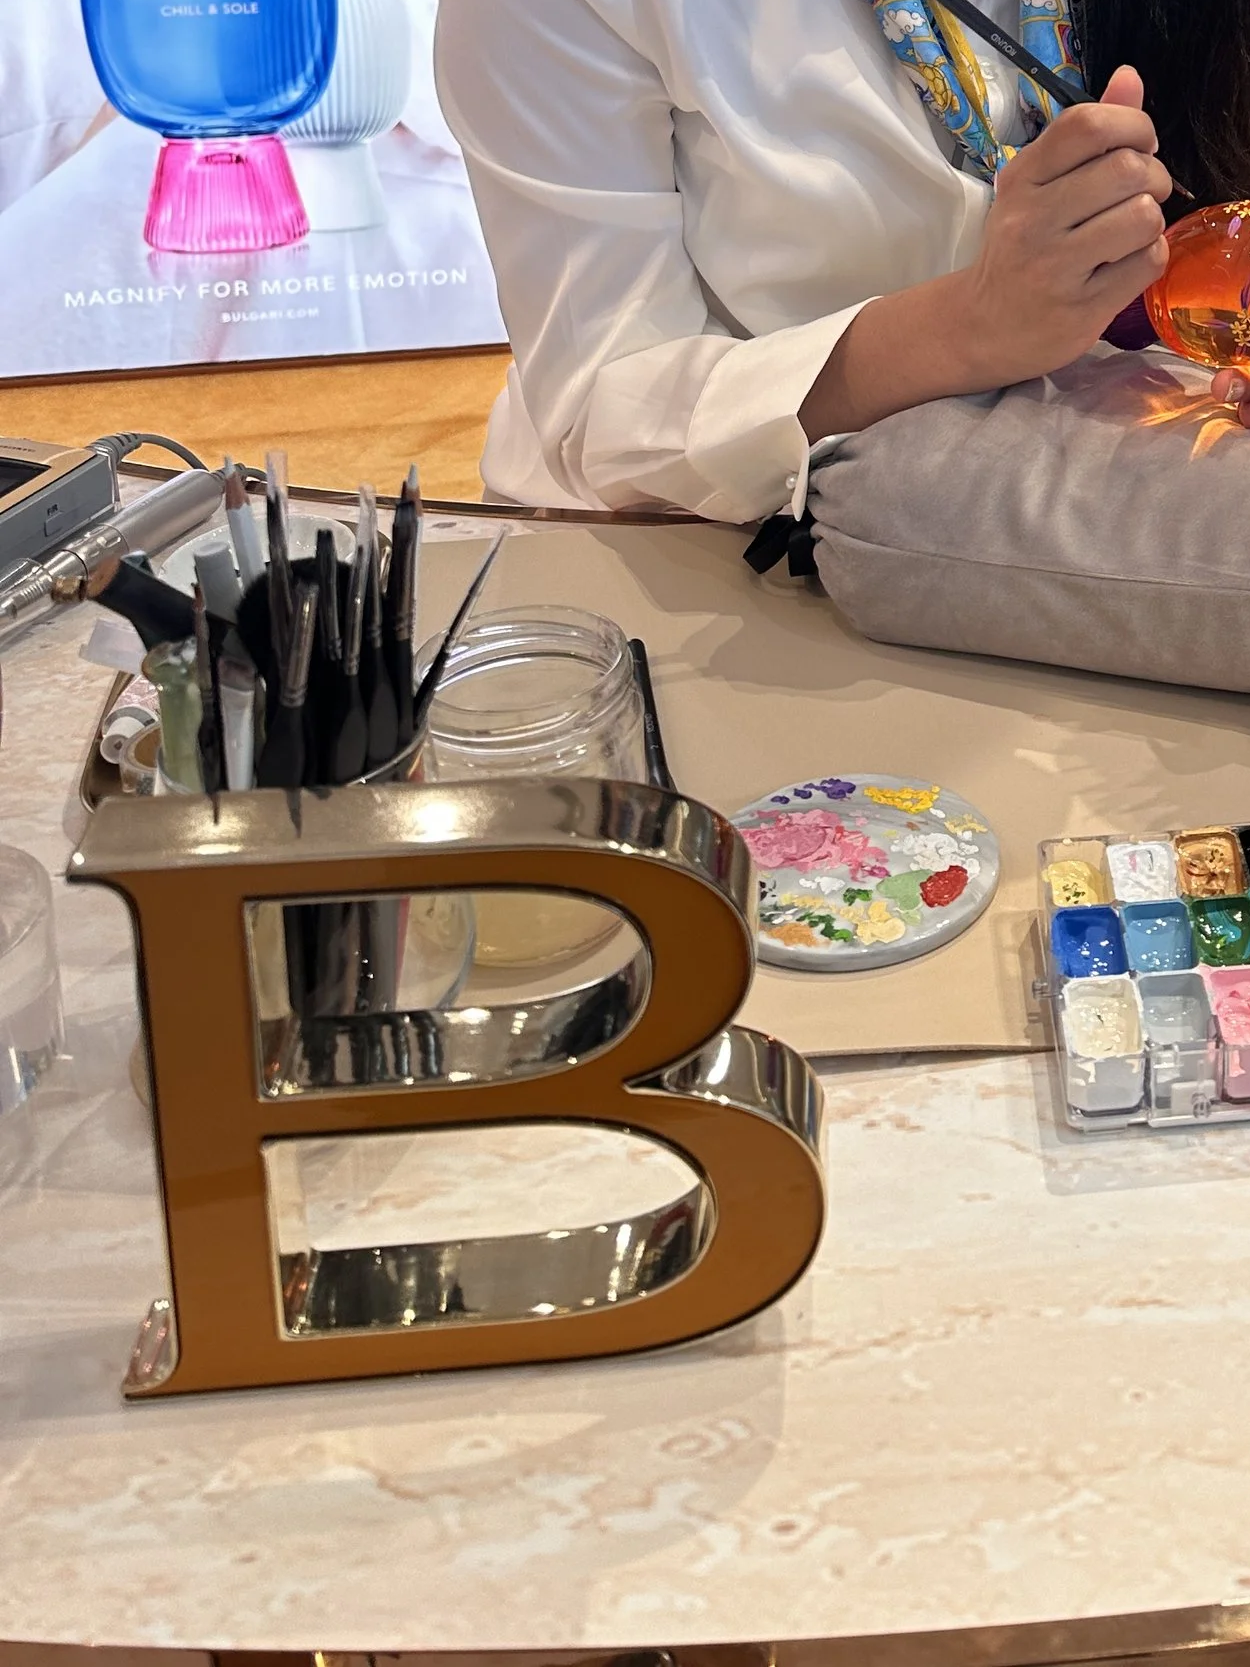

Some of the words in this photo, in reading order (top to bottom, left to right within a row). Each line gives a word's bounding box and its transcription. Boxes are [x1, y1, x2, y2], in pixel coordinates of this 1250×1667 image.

[160, 5, 202, 17] CHILL
[208, 3, 218, 15] &
[222, 1, 259, 14] SOLE
[991, 33, 1017, 56] ROUND
[64, 285, 187, 308] MAGNIFY
[199, 280, 249, 299] FOR
[261, 275, 336, 295] MORE
[347, 268, 468, 291] EMOTION
[67, 777, 825, 1404] B
